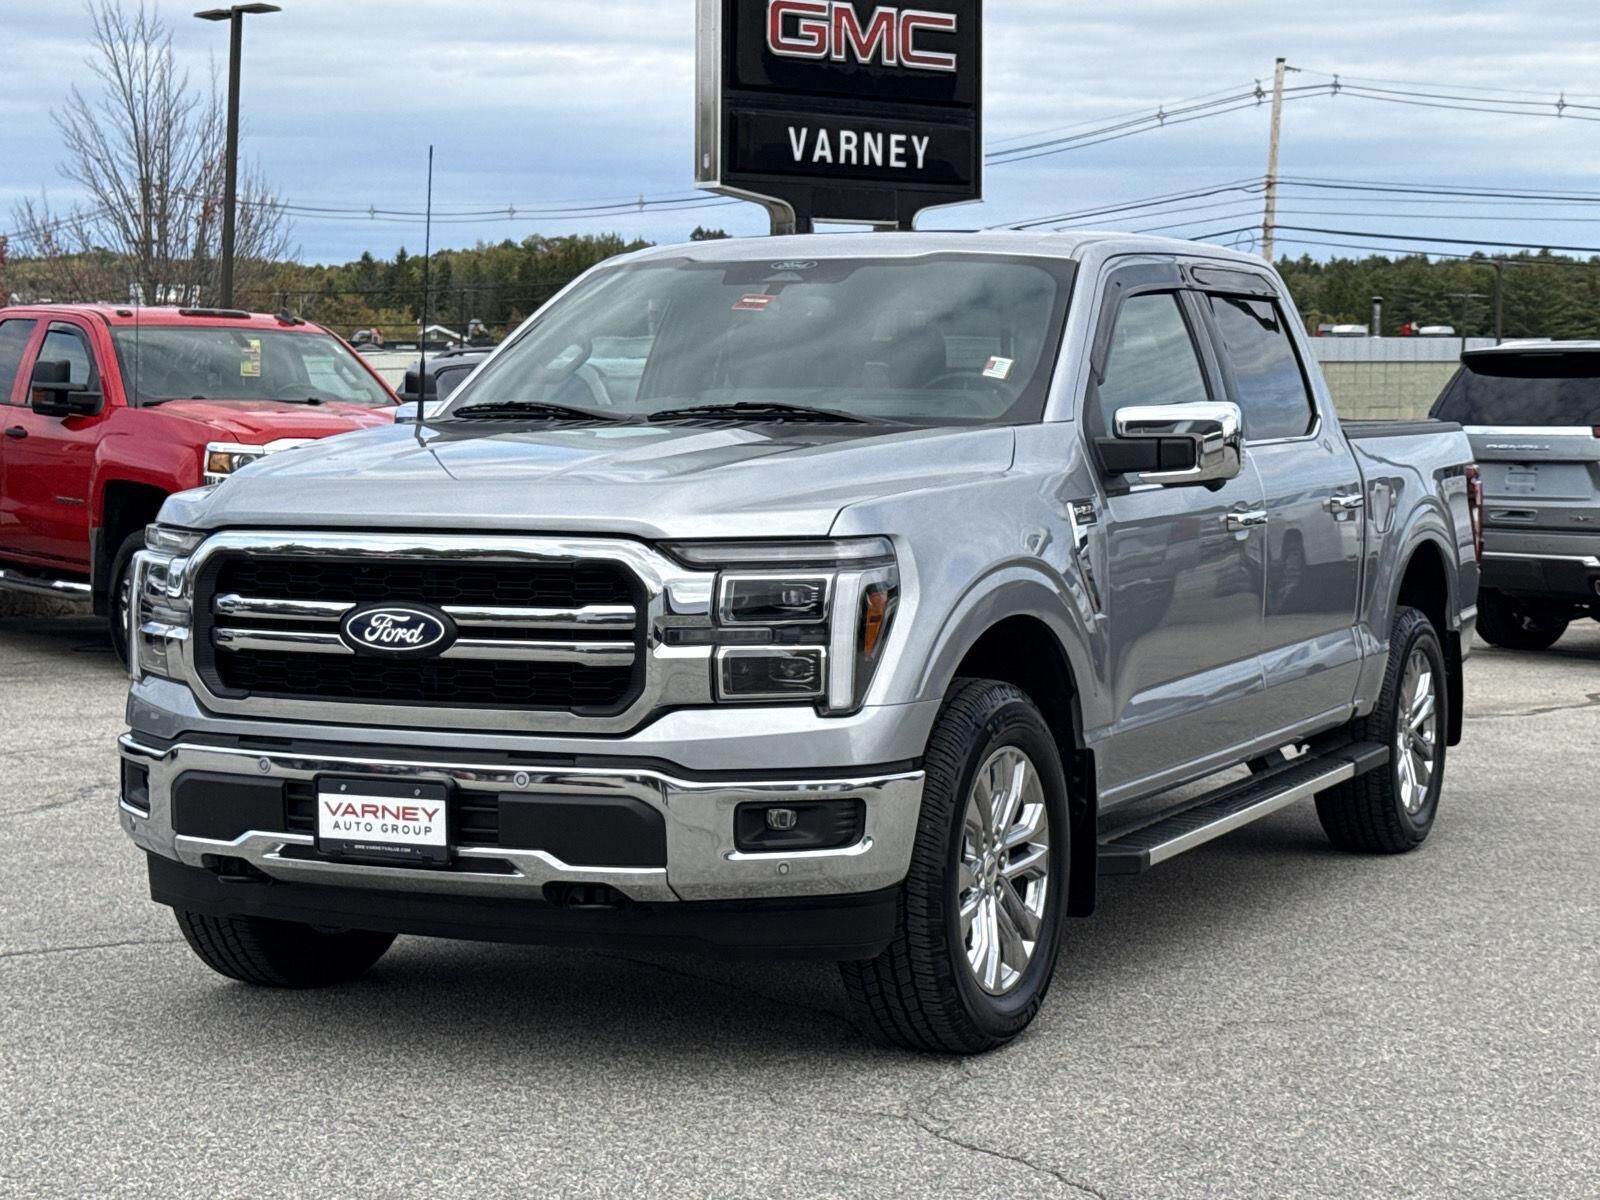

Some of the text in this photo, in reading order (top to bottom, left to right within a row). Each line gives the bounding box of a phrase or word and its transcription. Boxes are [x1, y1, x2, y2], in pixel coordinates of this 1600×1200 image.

[767, 0, 957, 72] GMC
[788, 126, 930, 169] VARNEY
[364, 613, 425, 643] Ford
[324, 801, 440, 822] VARNEY
[332, 820, 433, 836] AUTO GROUP
